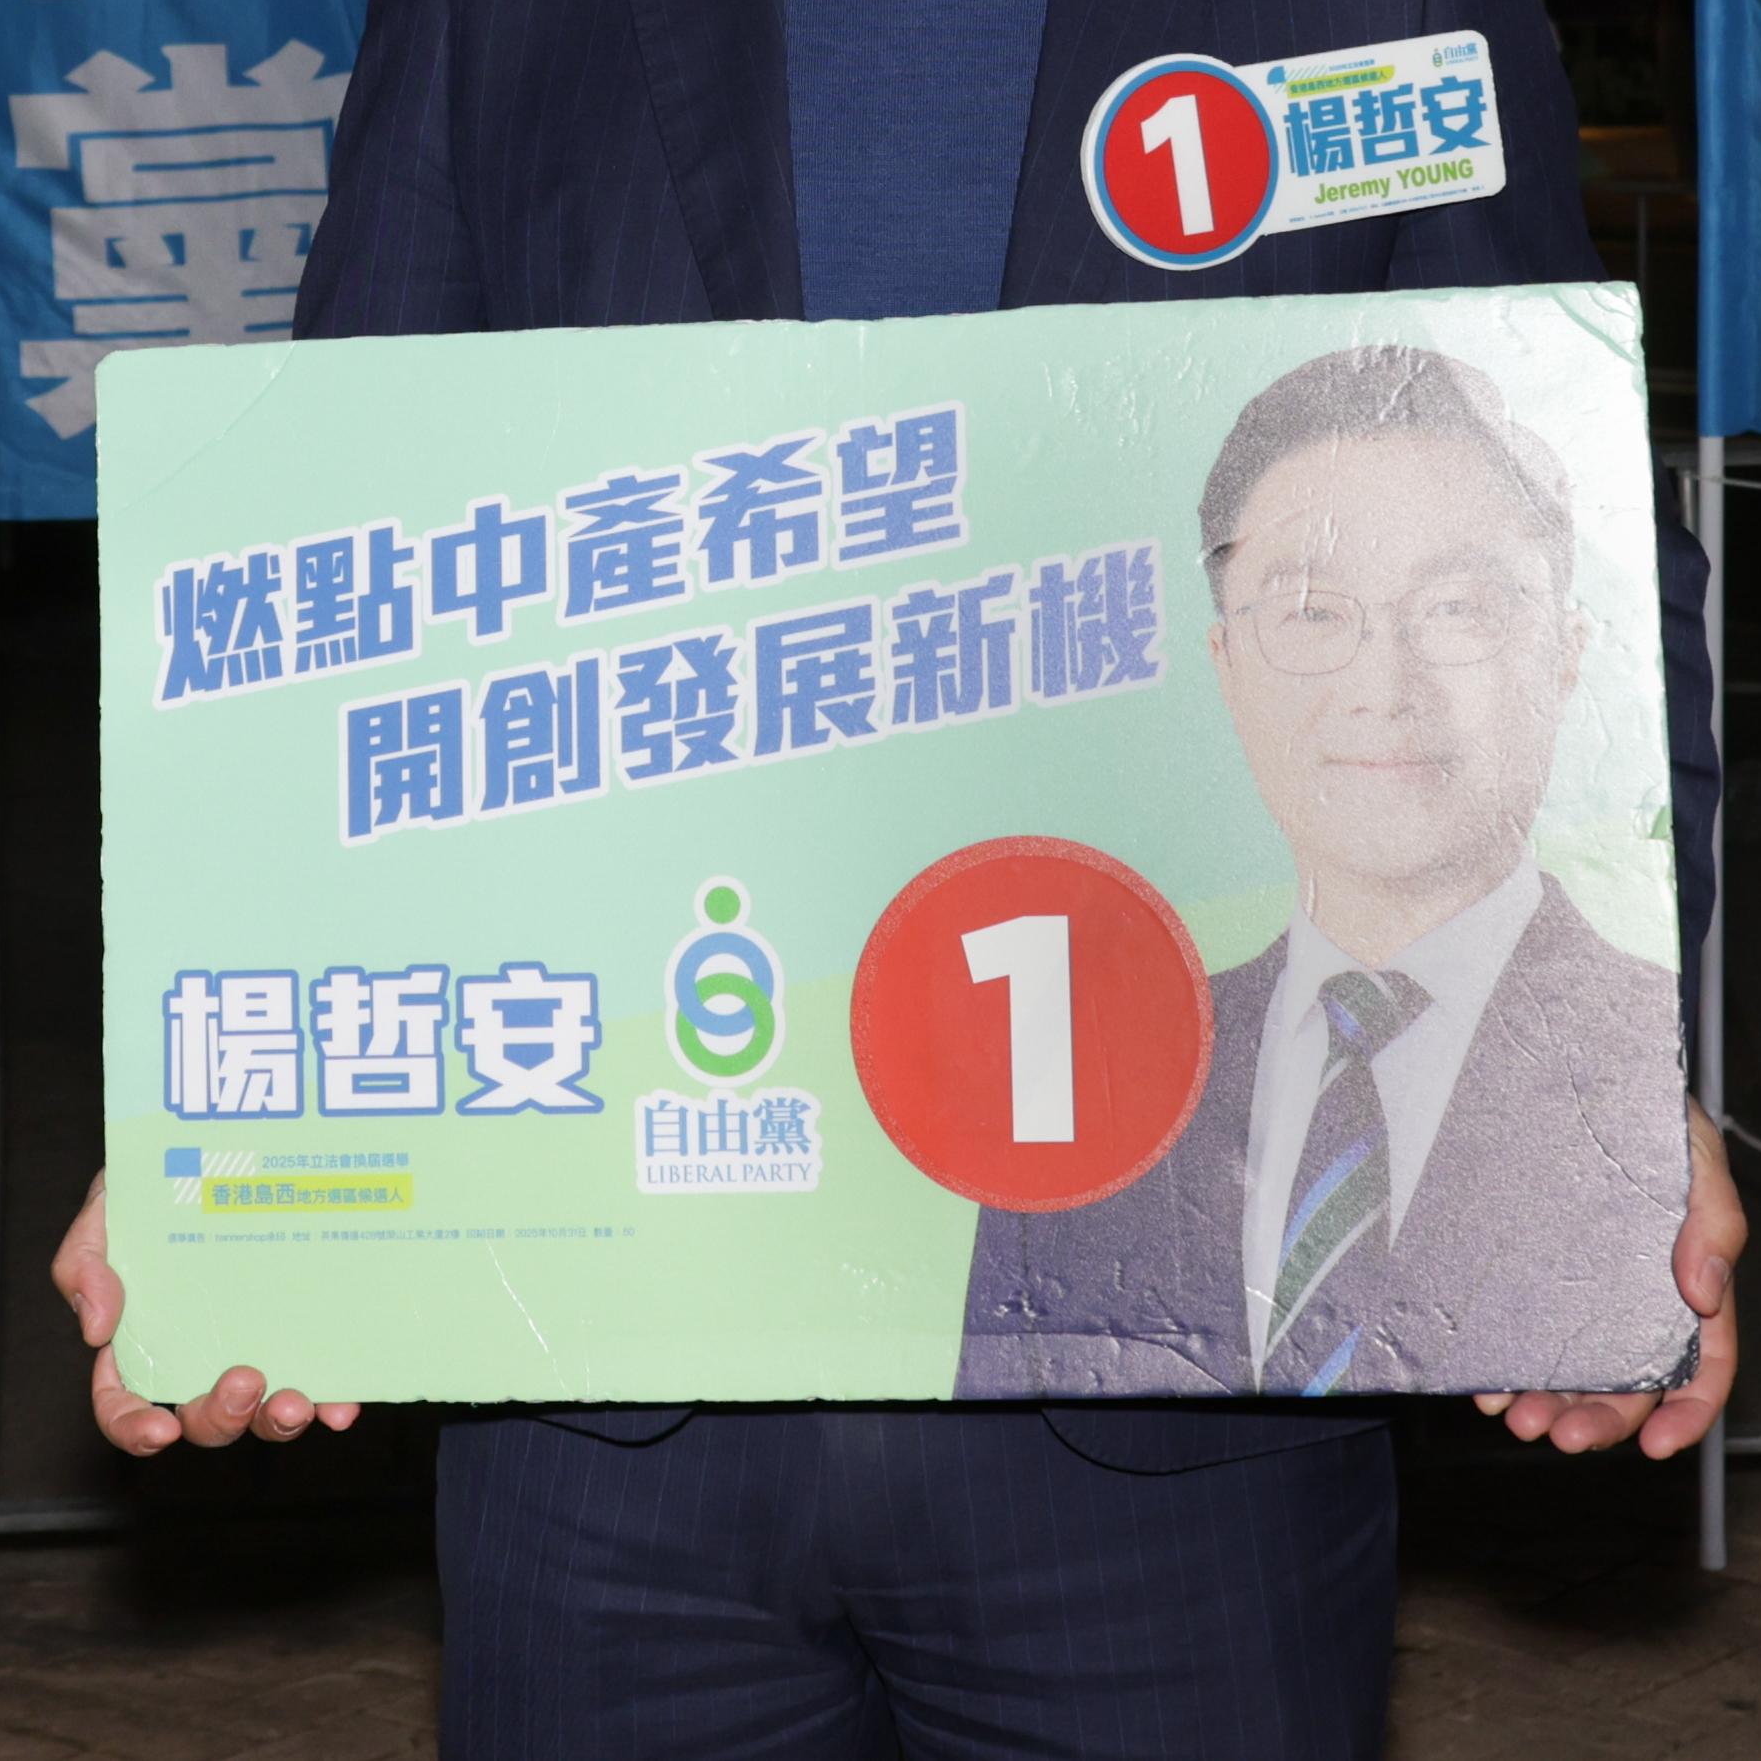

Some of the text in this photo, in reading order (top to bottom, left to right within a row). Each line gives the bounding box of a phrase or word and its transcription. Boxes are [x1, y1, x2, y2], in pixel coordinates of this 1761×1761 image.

[1141, 94, 1214, 236] 1
[1283, 76, 1492, 177] 楊哲安
[1313, 175, 1391, 205] Jeremy
[1397, 157, 1474, 190] YOUNG
[160, 408, 962, 701] 燃點中產希望
[345, 546, 1163, 839] 開創發展新機
[168, 968, 597, 1113] 楊哲安
[961, 915, 1075, 1144] 1
[644, 1097, 812, 1157] 自由黨
[646, 1163, 812, 1184] LIBERAL PARTY
[212, 1183, 404, 1206] 香港島西地方選區候選人
